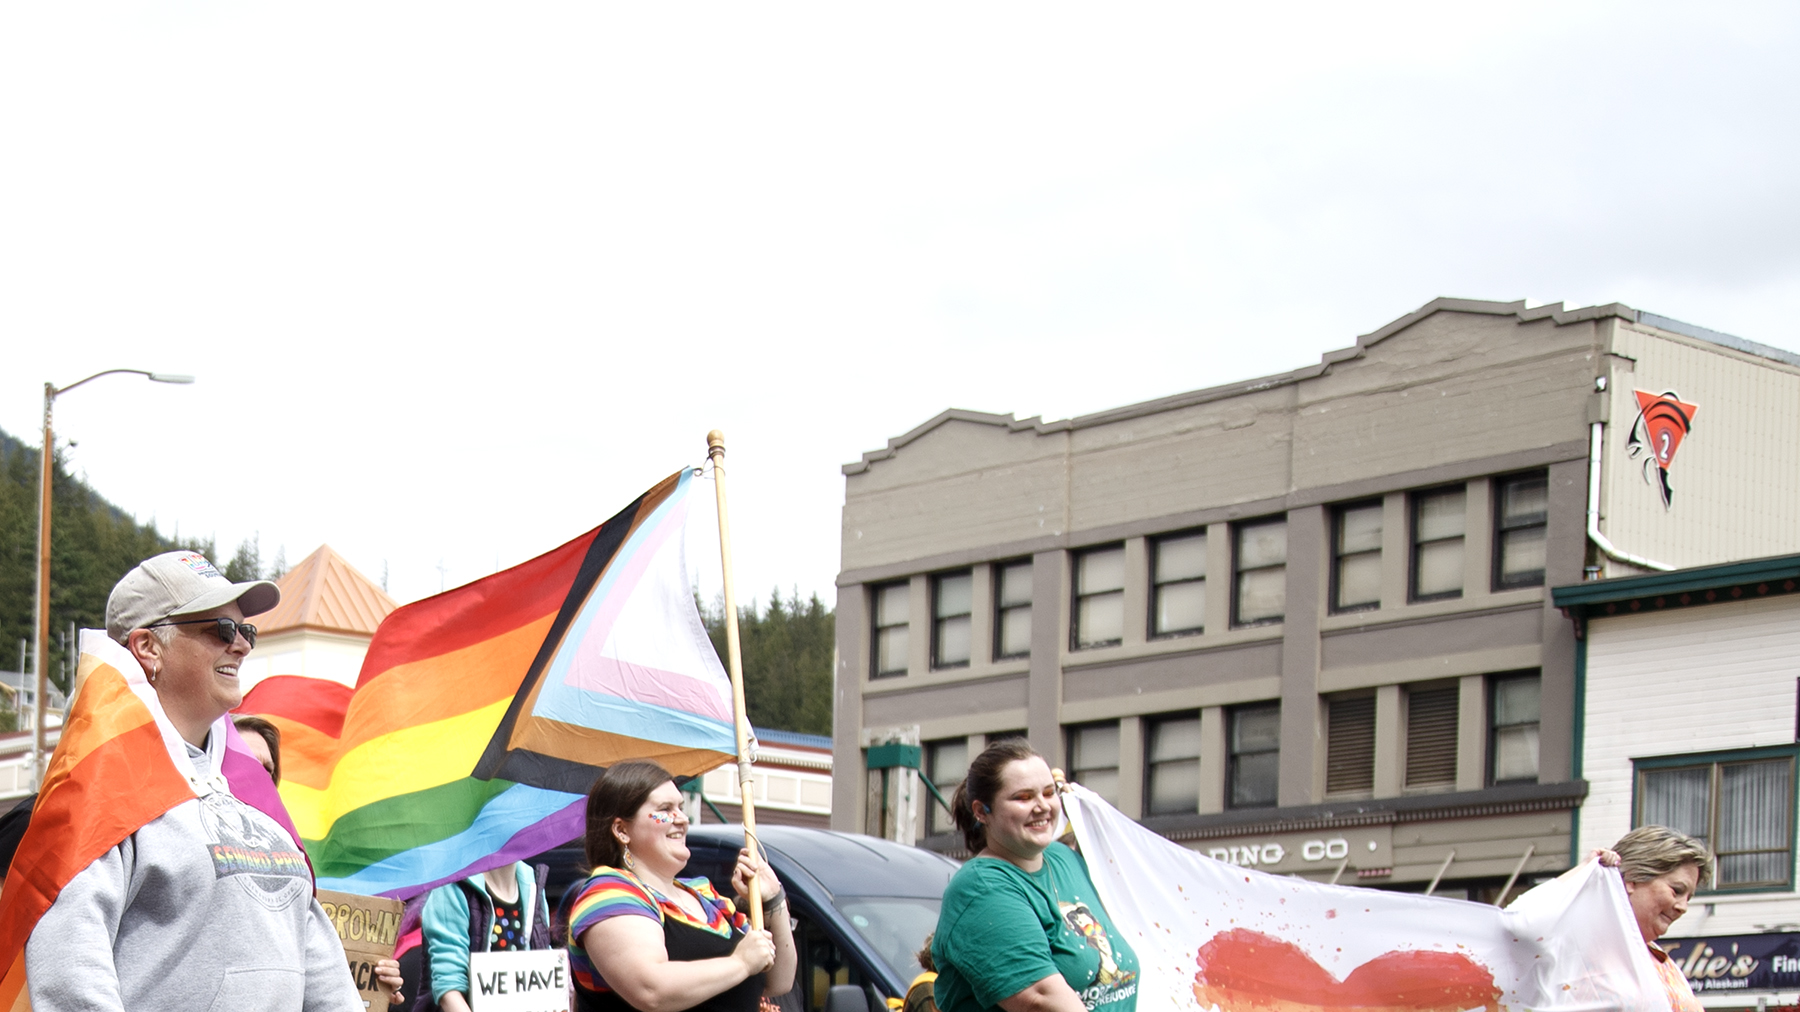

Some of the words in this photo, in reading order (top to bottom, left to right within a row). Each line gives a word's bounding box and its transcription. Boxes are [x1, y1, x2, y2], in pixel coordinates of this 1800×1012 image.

[1303, 838, 1348, 862] CO
[1773, 955, 1800, 973] Fin
[477, 971, 508, 996] WE
[515, 966, 565, 993] HAVE
[1705, 978, 1749, 990] Alaskan!
